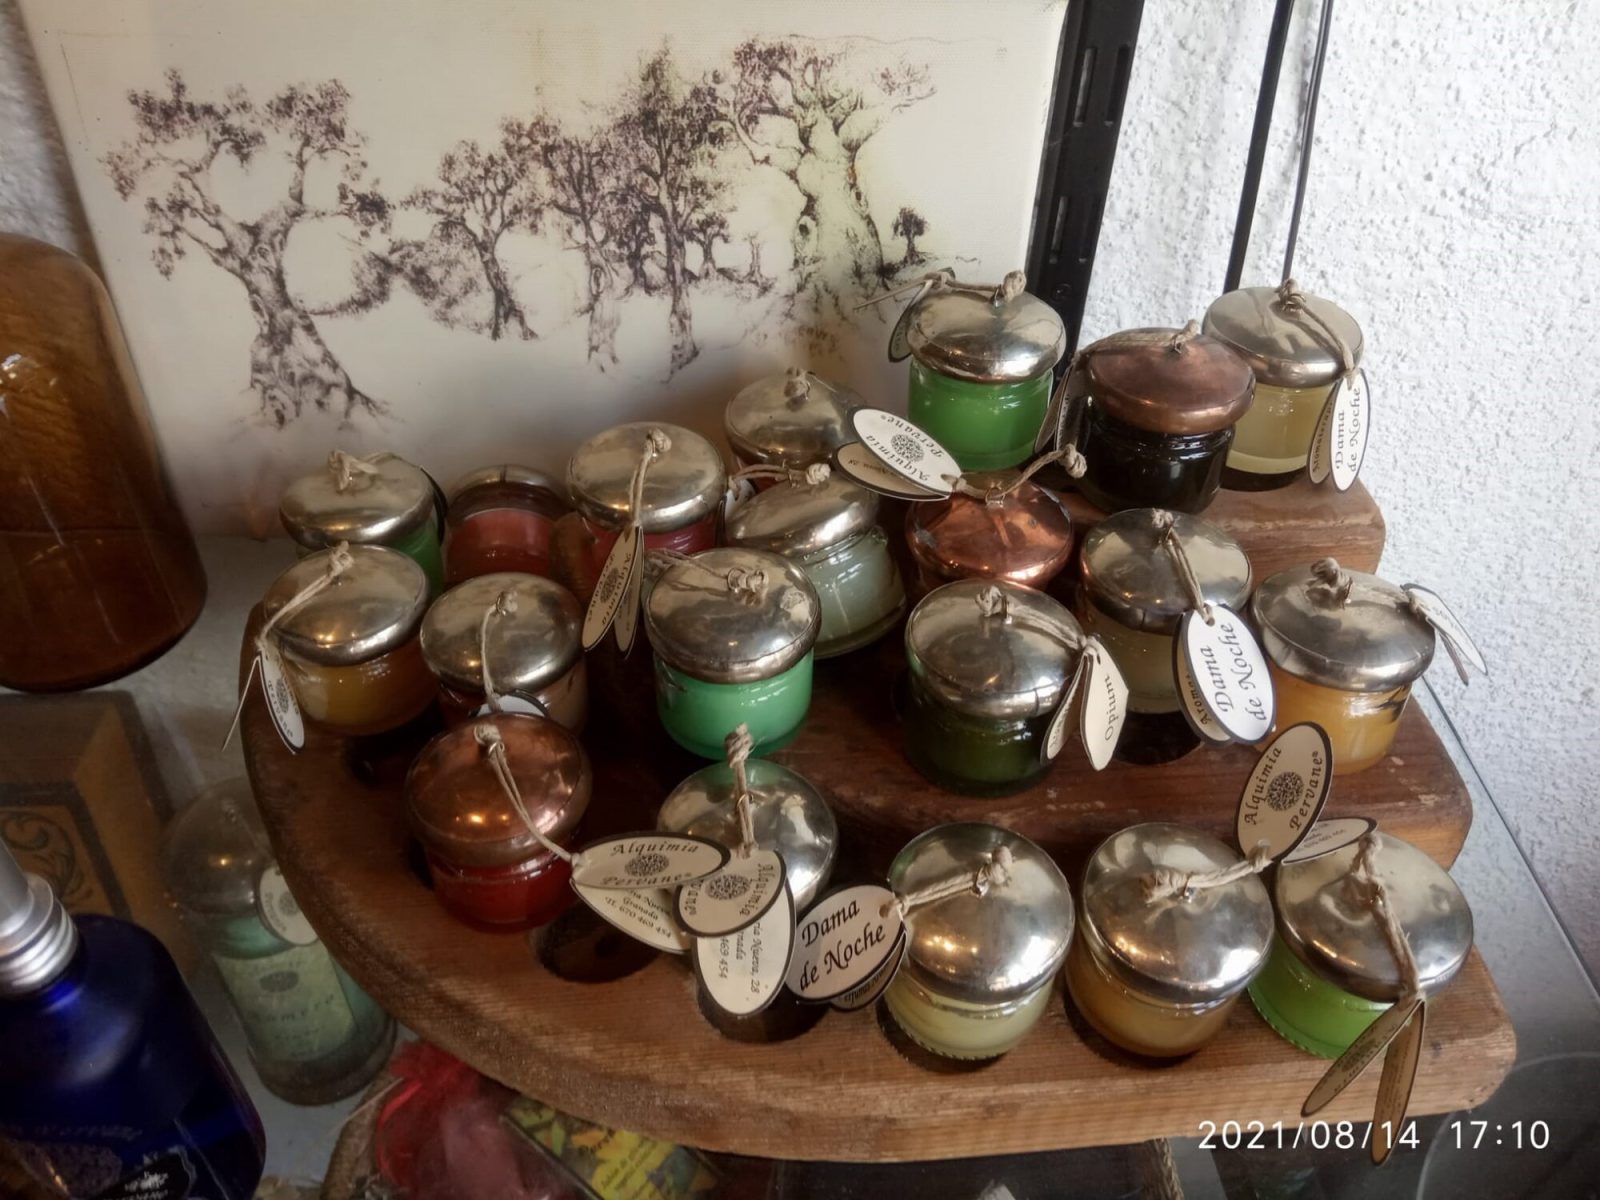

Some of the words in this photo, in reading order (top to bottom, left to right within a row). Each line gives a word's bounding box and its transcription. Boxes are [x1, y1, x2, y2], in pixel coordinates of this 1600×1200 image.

[1335, 410, 1345, 469] Dama
[1349, 388, 1361, 446] Noche
[866, 435, 930, 481] Alquimia
[1347, 453, 1358, 472] de
[1200, 645, 1234, 713] Dama
[1218, 622, 1256, 691] Noche
[1244, 697, 1267, 721] de
[1243, 747, 1282, 825] Alquimia
[610, 840, 699, 856] Alquimia
[801, 900, 860, 948] Dama
[719, 959, 728, 979] 454
[800, 960, 820, 992] de
[823, 922, 886, 975] Noche
[751, 980, 761, 994] 28
